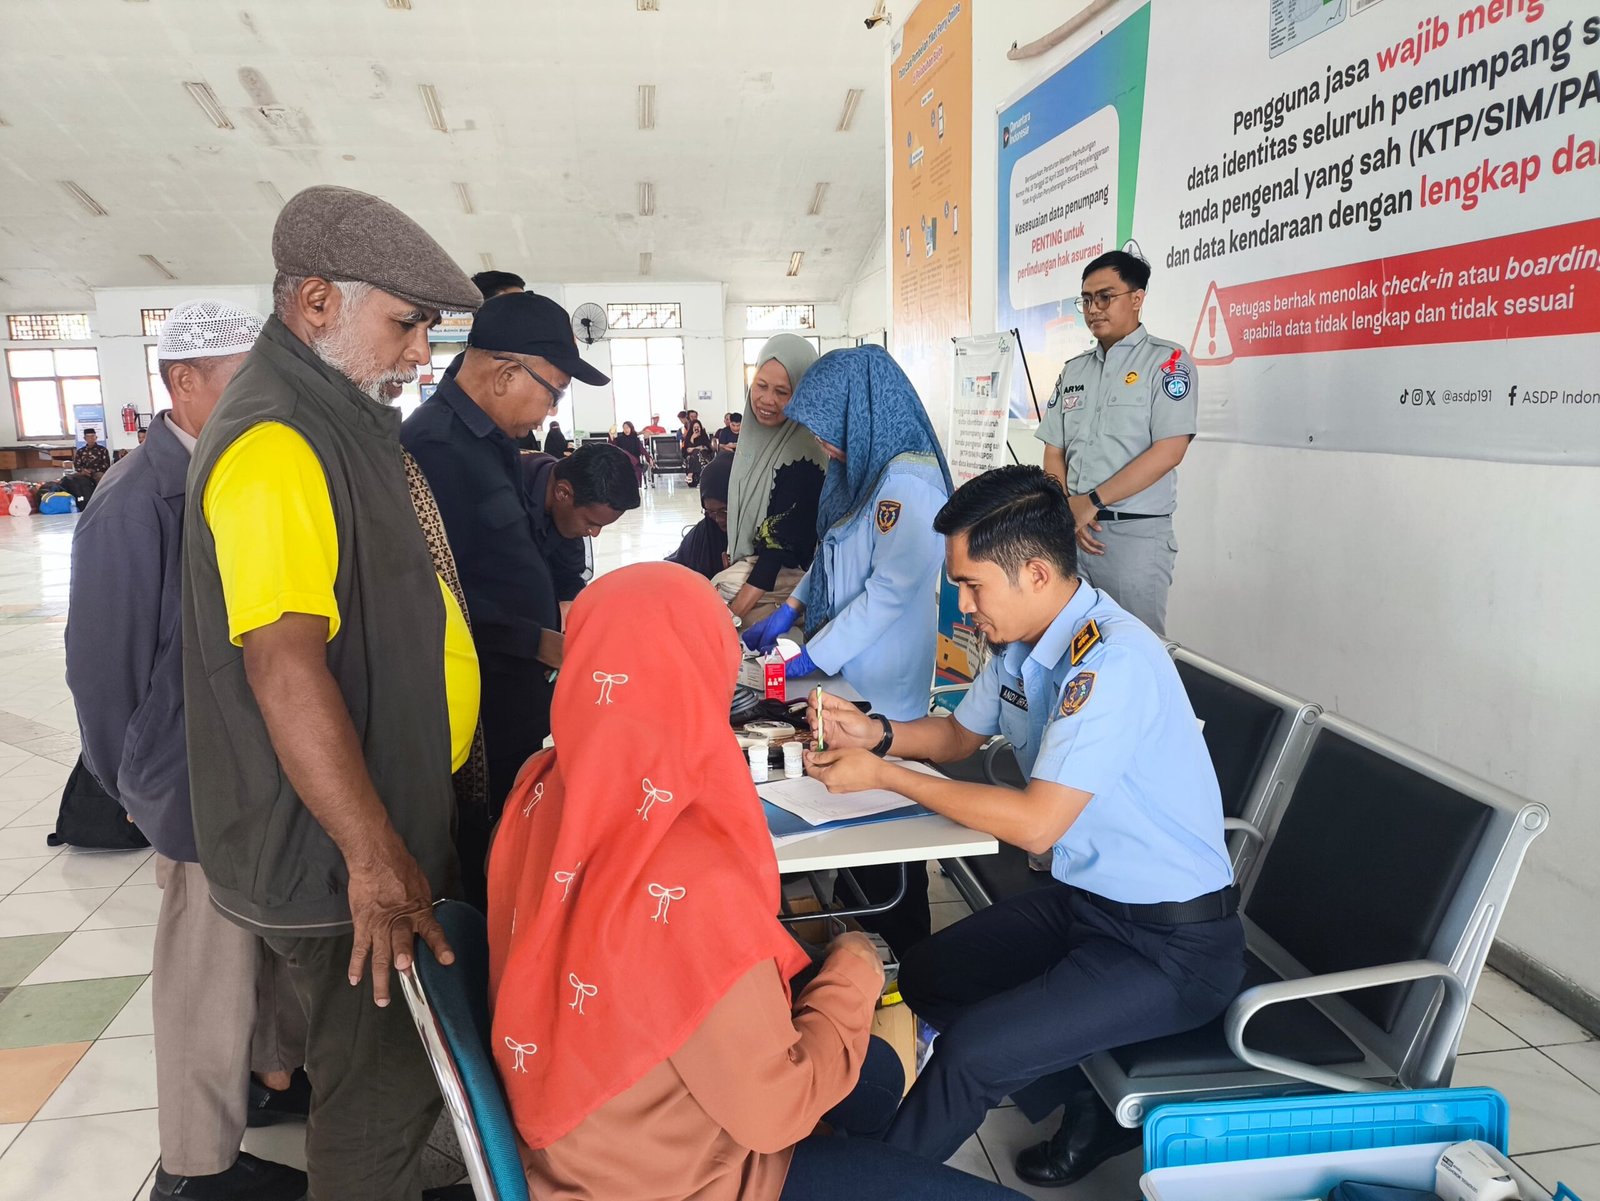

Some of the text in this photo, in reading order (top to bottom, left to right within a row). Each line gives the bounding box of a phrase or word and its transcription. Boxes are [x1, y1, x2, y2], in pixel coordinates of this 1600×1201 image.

[1233, 81, 1320, 135] Pengguna
[1324, 58, 1370, 103] jasa
[1376, 15, 1450, 73] wajib
[1187, 163, 1219, 191] data
[1222, 133, 1298, 179] identitas
[1302, 94, 1385, 149] seluruh
[1391, 20, 1574, 126] penumpang
[1166, 133, 1600, 269] dan data kendaraan dengan lengkap da
[1179, 198, 1219, 230] tanda
[1222, 167, 1299, 223] pengenal
[1304, 154, 1354, 200] yang
[1360, 136, 1401, 175] sah
[1014, 184, 1110, 236] Kesesuaian data penumpang
[1017, 237, 1104, 283] perlindungan hak asuransi
[1031, 221, 1085, 254] PENTING untuk
[1229, 298, 1271, 320] Petugas
[1274, 288, 1316, 312] berhak
[1319, 279, 1378, 305] menolak
[1381, 267, 1453, 297] check-in
[1458, 265, 1501, 287] atau
[1243, 284, 1575, 344] apabila data tidak lengkap dan tidak sesuai
[1063, 384, 1085, 395] ARYA
[1442, 388, 1492, 404] @asdp191
[1522, 390, 1558, 404] ASDP
